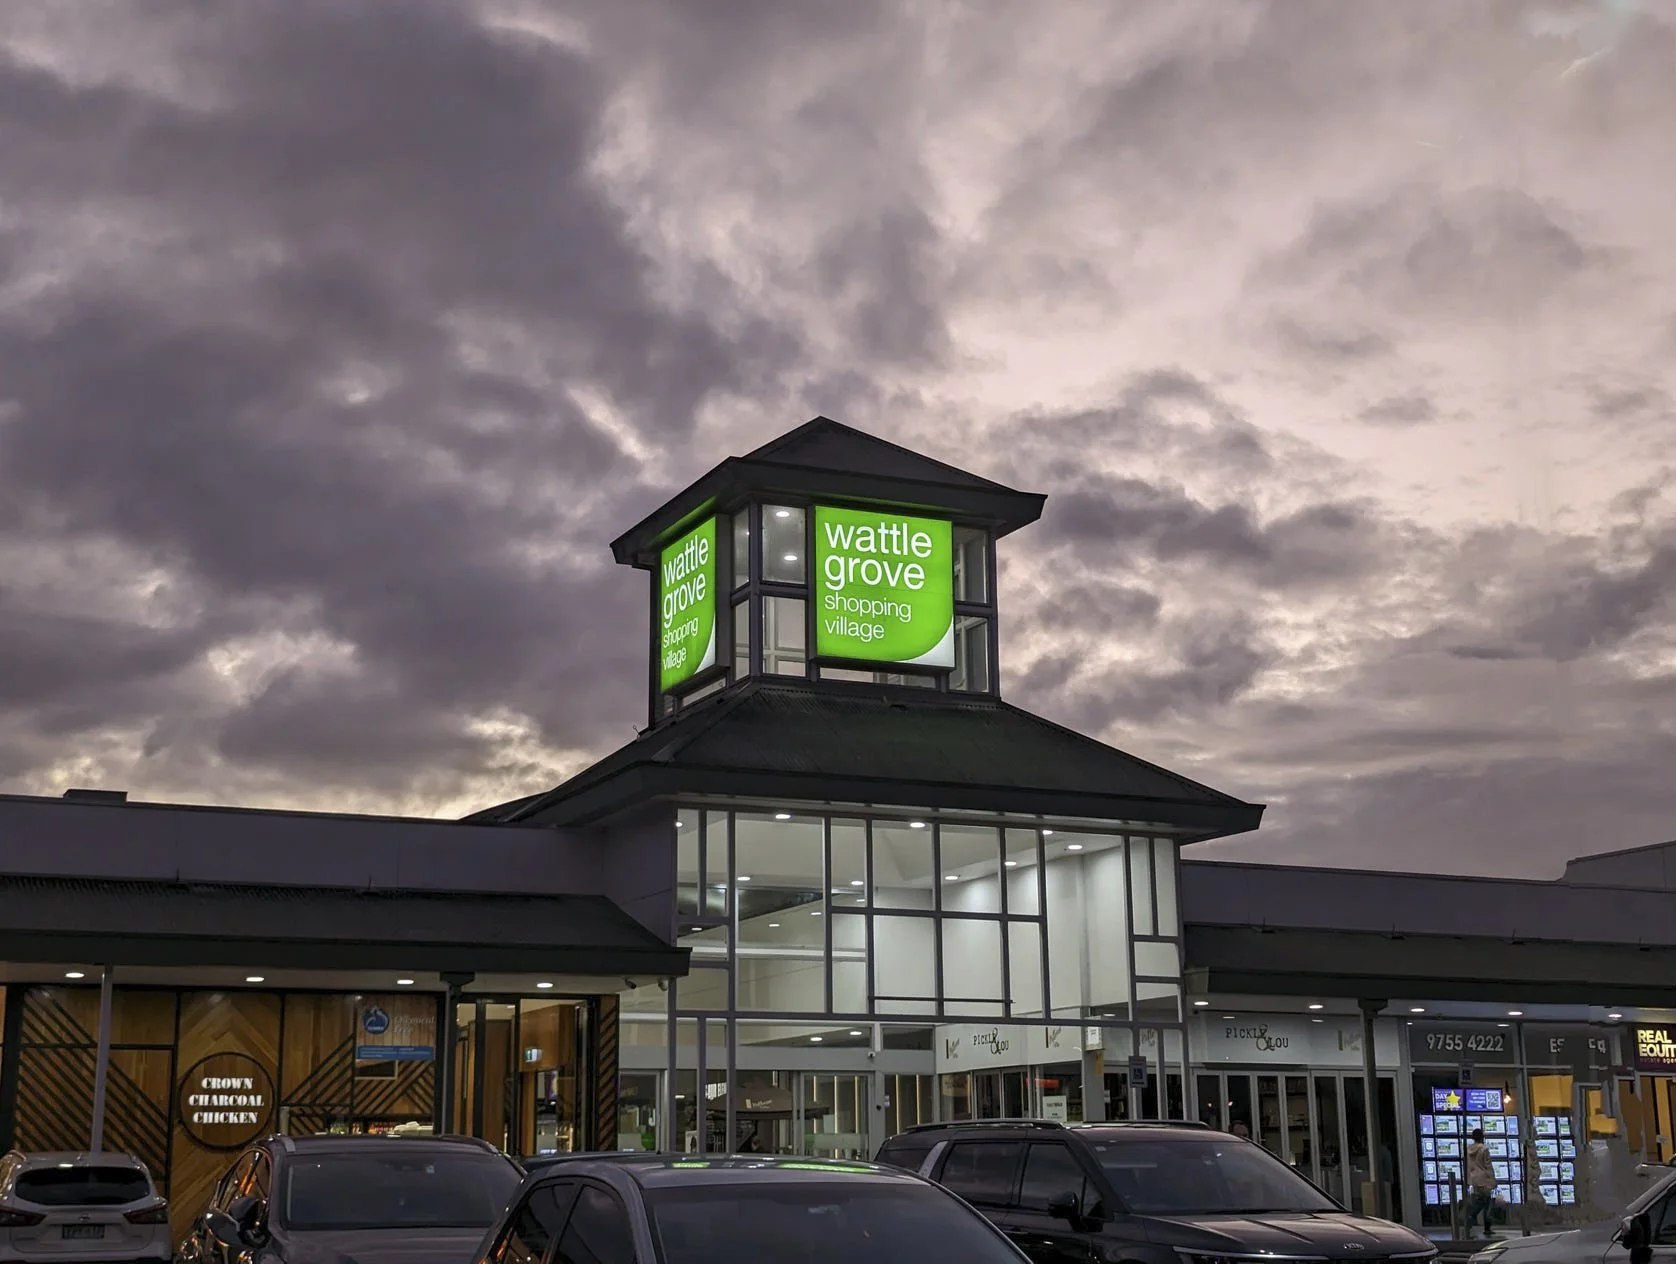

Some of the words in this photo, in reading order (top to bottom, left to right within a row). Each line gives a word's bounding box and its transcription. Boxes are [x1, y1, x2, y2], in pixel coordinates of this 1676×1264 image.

[824, 521, 933, 558] wattle
[663, 534, 709, 588] wattle
[824, 554, 926, 592] grove
[663, 572, 706, 629] grove
[824, 591, 912, 623] shopping
[663, 616, 699, 649] shopping
[824, 616, 885, 642] village
[662, 647, 687, 671] village
[1427, 1034, 1463, 1051] 9755
[1467, 1036, 1504, 1051] 4222
[1637, 1029, 1672, 1043] REAL
[201, 1077, 254, 1089] CROWN
[188, 1094, 265, 1107] CHARCOAL
[193, 1111, 259, 1124] CHICKEN
